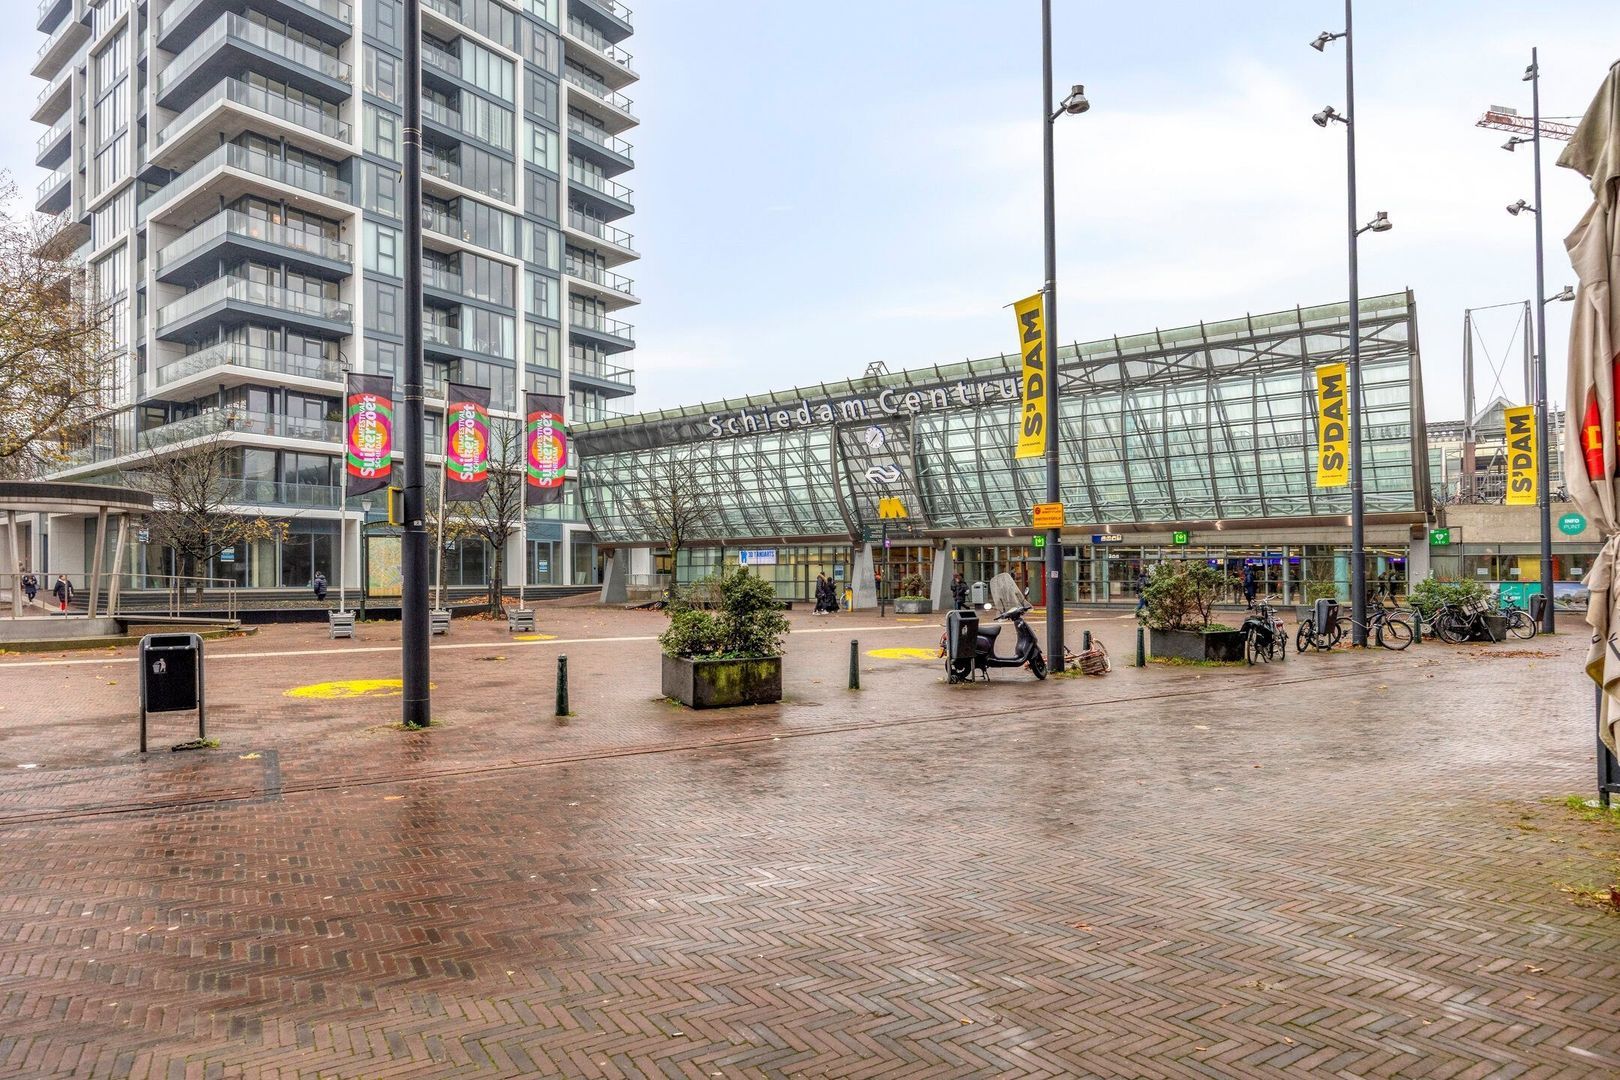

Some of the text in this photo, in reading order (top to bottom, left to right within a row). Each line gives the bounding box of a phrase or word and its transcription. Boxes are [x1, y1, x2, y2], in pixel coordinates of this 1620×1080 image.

[708, 377, 1018, 437] Schiedam Centru
[1020, 308, 1044, 437] S'DAM
[360, 395, 377, 477] Suikerzoet
[374, 433, 382, 468] SCHIEDAM
[457, 410, 465, 453] FILMFESTIVAL
[460, 404, 475, 480] Suikerzoet
[539, 413, 553, 486] Suikerzoet
[1321, 373, 1344, 471] S'DAM
[1509, 414, 1532, 492] S'DAM
